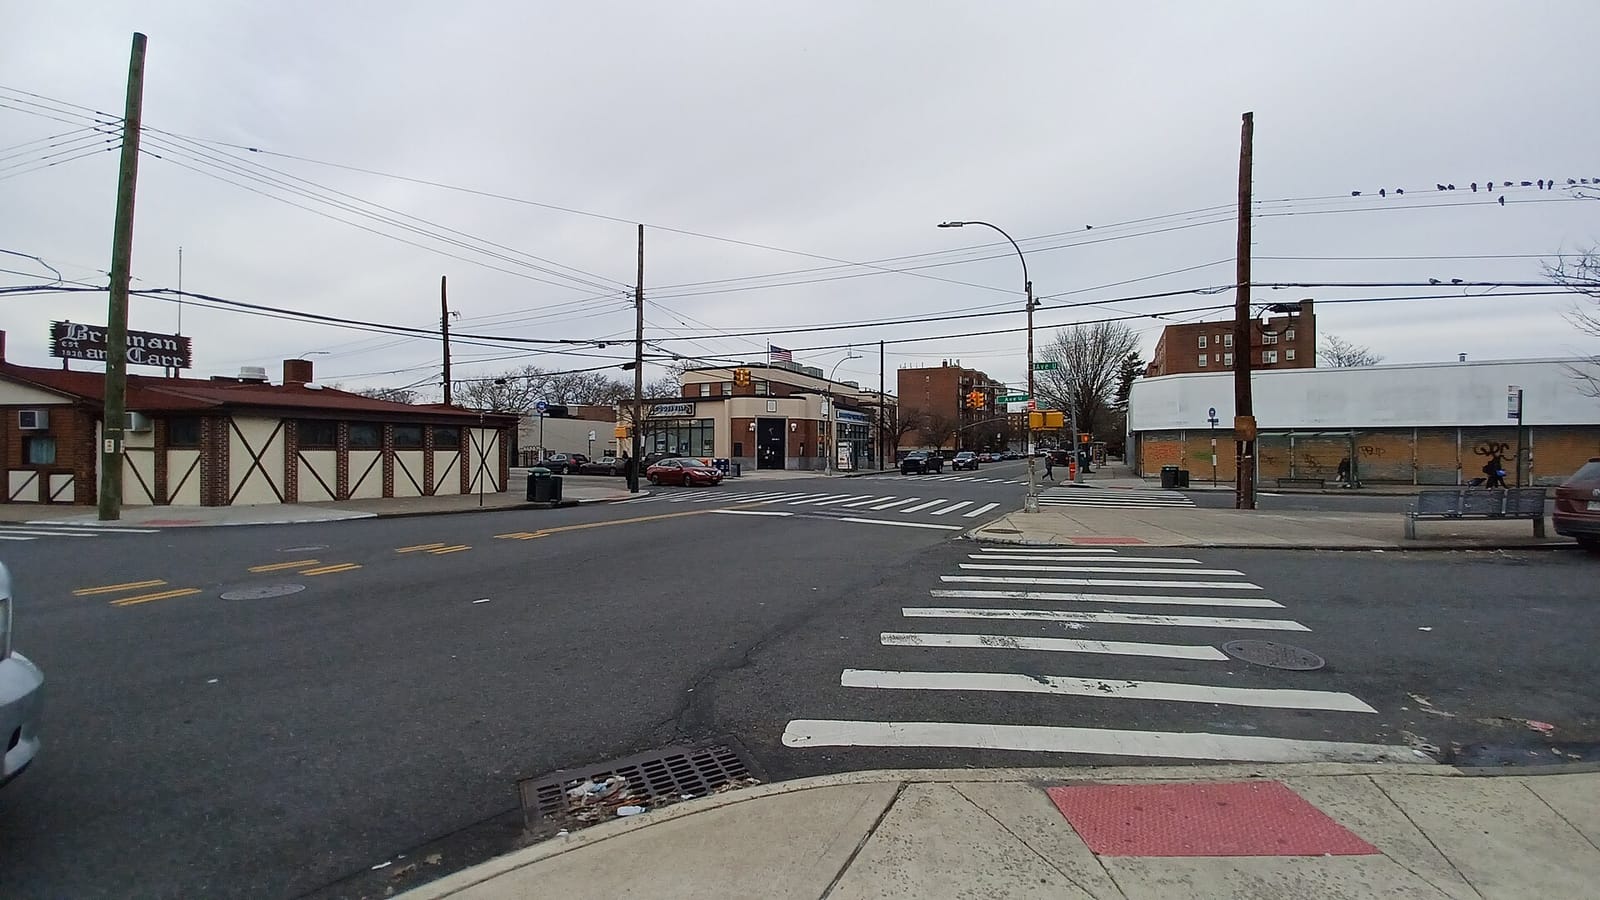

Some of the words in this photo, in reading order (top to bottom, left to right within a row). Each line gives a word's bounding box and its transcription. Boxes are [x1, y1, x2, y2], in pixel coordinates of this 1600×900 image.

[59, 323, 178, 351] Brnan
[86, 349, 107, 360] an
[126, 347, 183, 367] Carr
